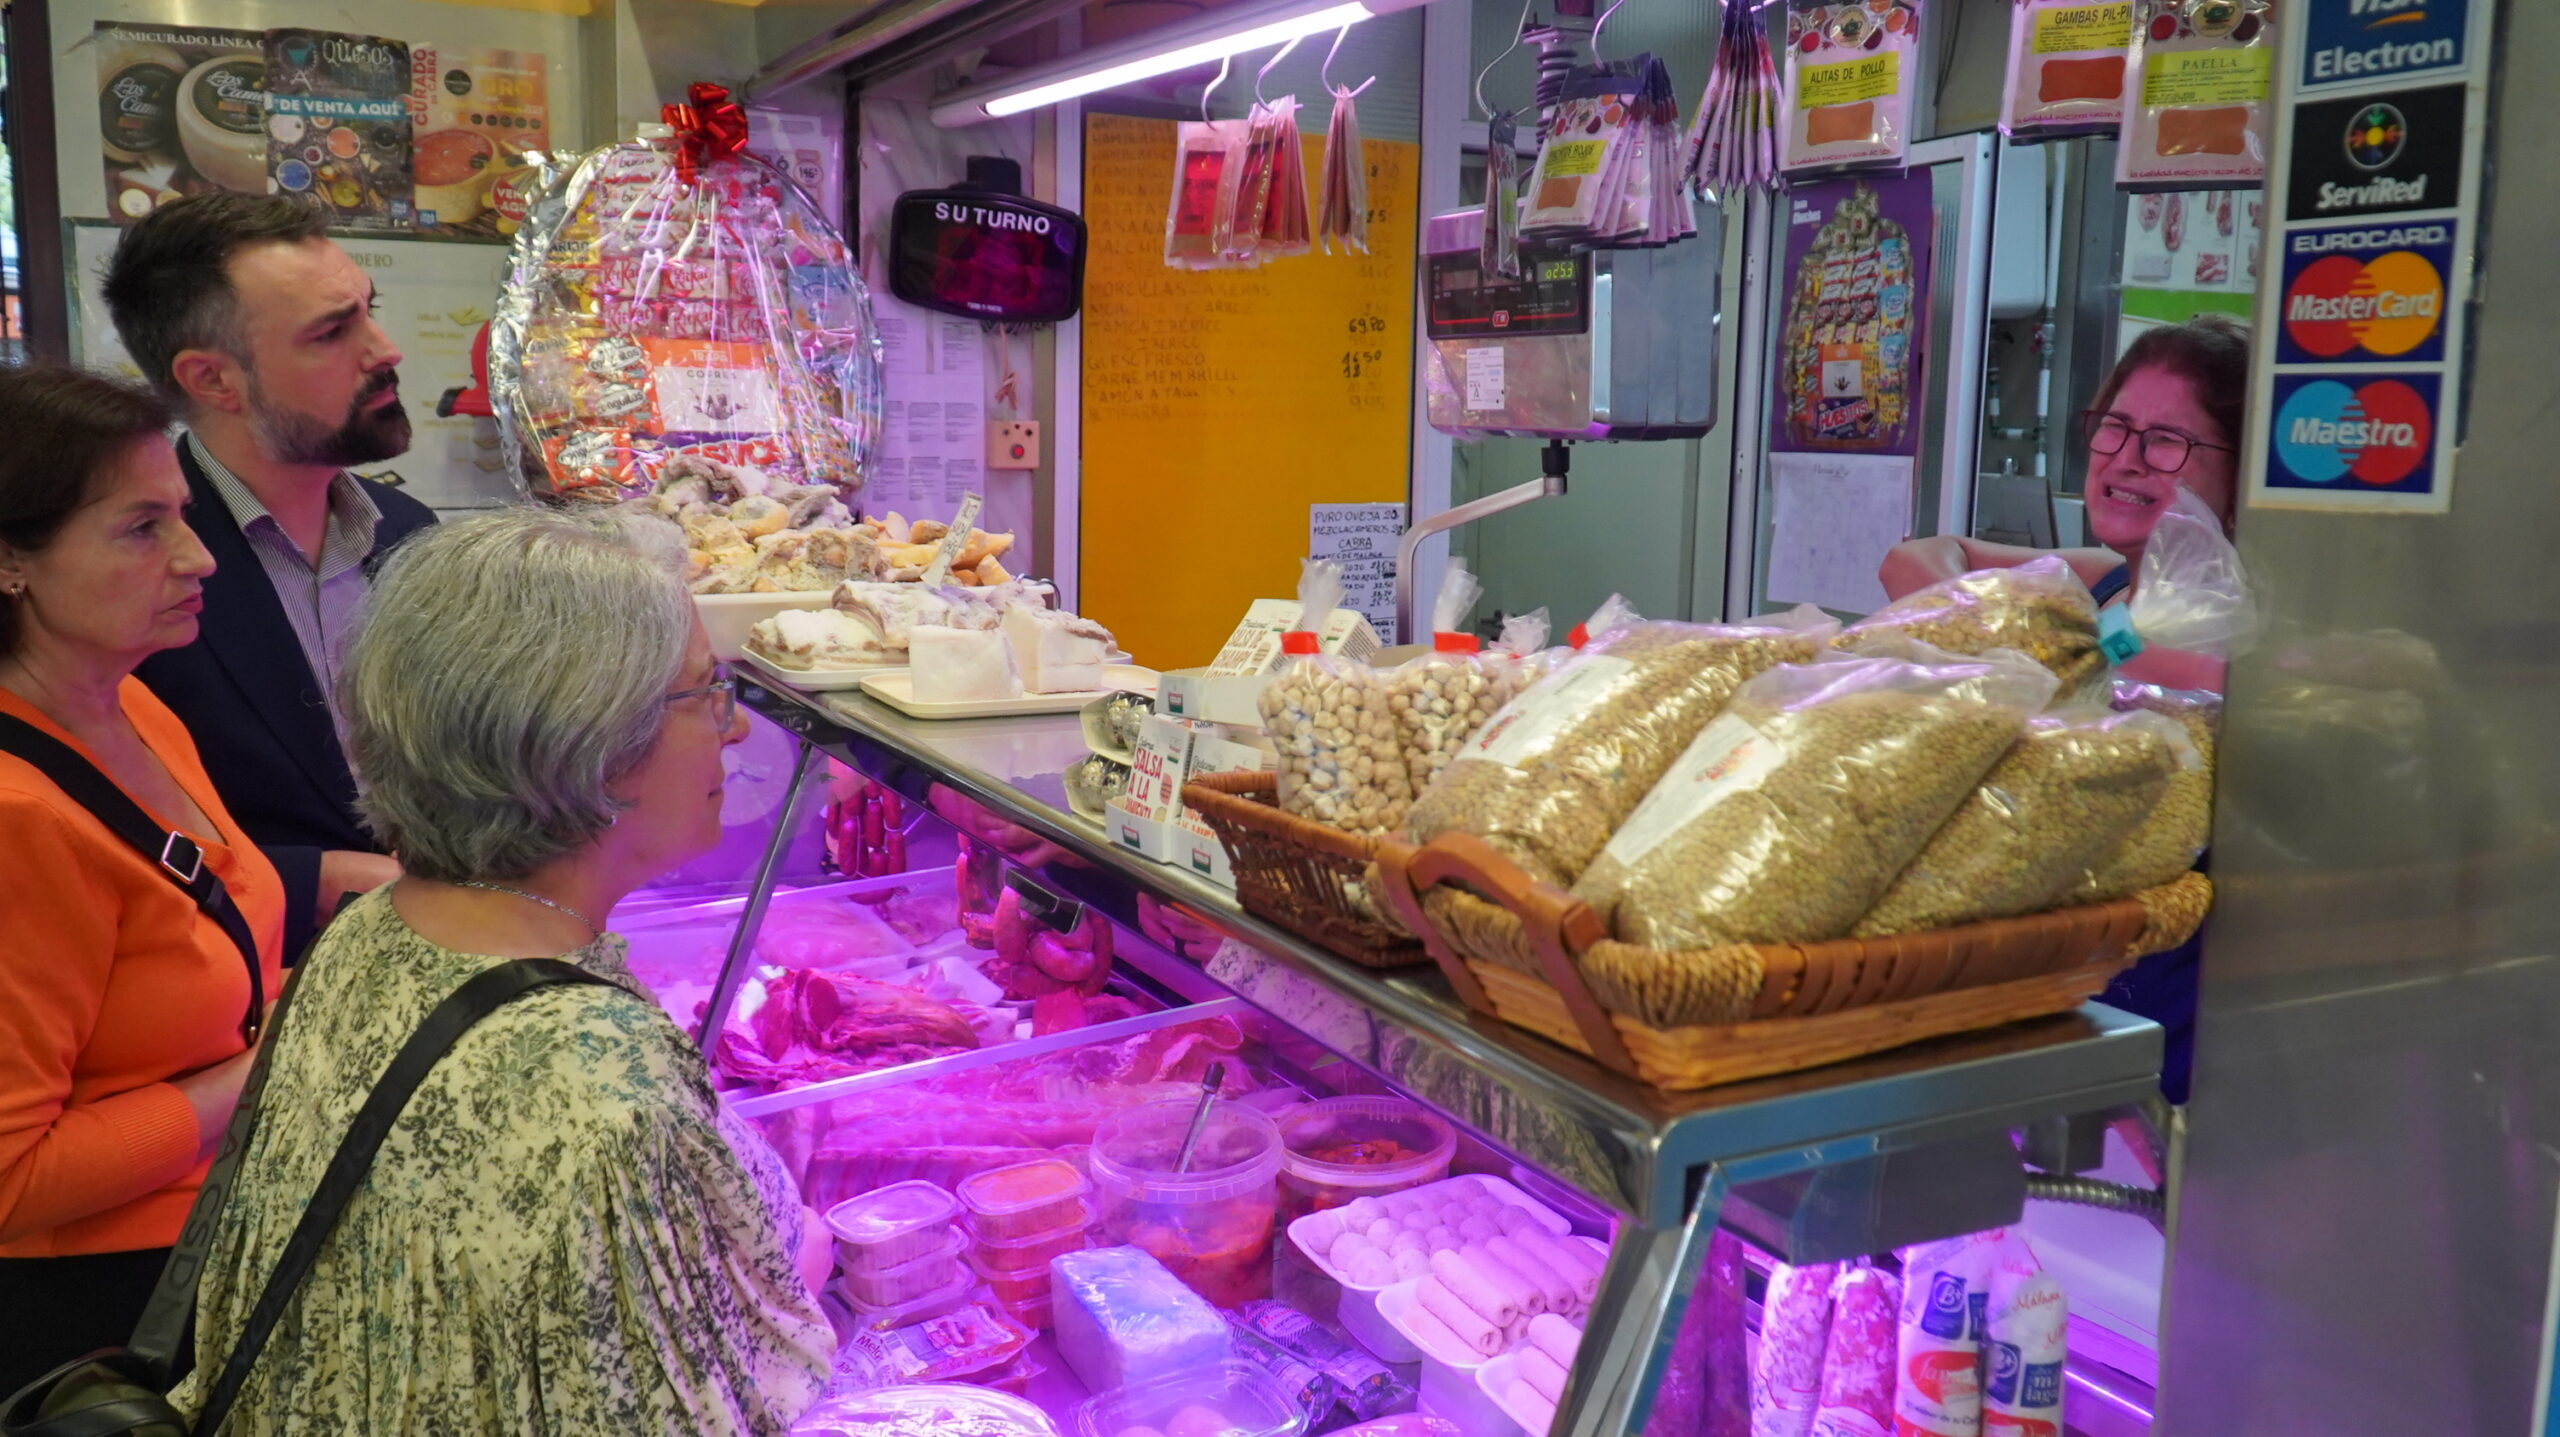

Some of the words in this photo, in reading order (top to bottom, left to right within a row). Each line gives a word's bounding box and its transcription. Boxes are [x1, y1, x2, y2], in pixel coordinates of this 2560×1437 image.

[2054, 9, 2099, 25] GAMBAS
[111, 29, 209, 46] SEMICURADO
[1810, 68, 1839, 84] ALITAS
[1842, 67, 1855, 80] DE
[1860, 59, 1886, 77] POLLO
[2181, 58, 2238, 70] PAELLA
[2313, 37, 2455, 78] Electron
[412, 48, 428, 126] CURADO
[304, 101, 355, 114] VENTA
[2316, 173, 2428, 210] ServiRed
[973, 207, 1051, 235] TURNO
[2293, 225, 2446, 253] EUROCARD
[2287, 289, 2436, 321] MasterCard
[2290, 416, 2413, 447] Maestro
[1133, 747, 1164, 781] SALSA
[1127, 772, 1136, 796] A
[1136, 775, 1150, 803] LA
